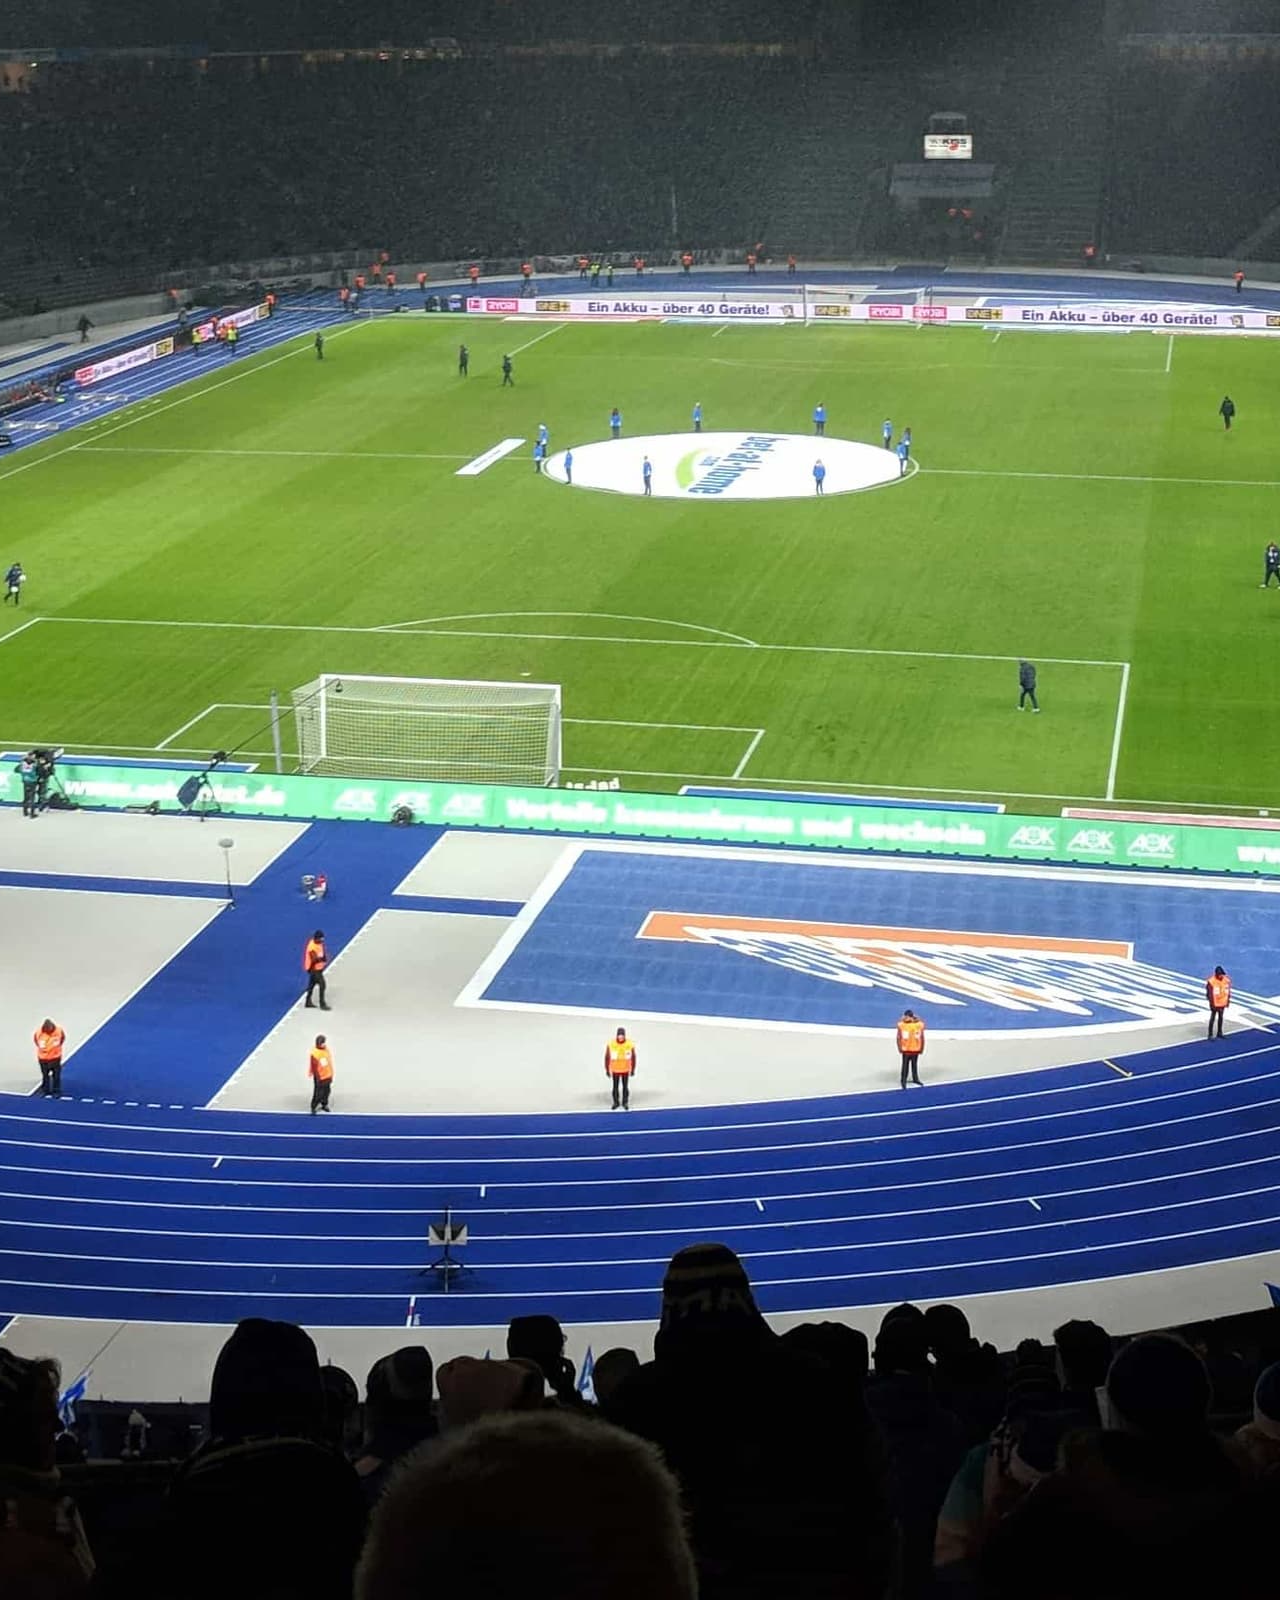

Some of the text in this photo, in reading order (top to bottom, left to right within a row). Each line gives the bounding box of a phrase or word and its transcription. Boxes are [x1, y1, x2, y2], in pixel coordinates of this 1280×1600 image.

[587, 302, 609, 313] Ein
[613, 302, 648, 314] Akku
[662, 302, 695, 315] über
[697, 303, 714, 315] 40
[719, 303, 770, 316] Geräte!
[1022, 309, 1043, 321] Ein
[1048, 310, 1086, 322] Akku
[1102, 310, 1134, 323] über
[1139, 313, 1158, 325] 40
[1163, 312, 1218, 326] Geräte!
[1008, 825, 1176, 855] AOK AOK AOK
